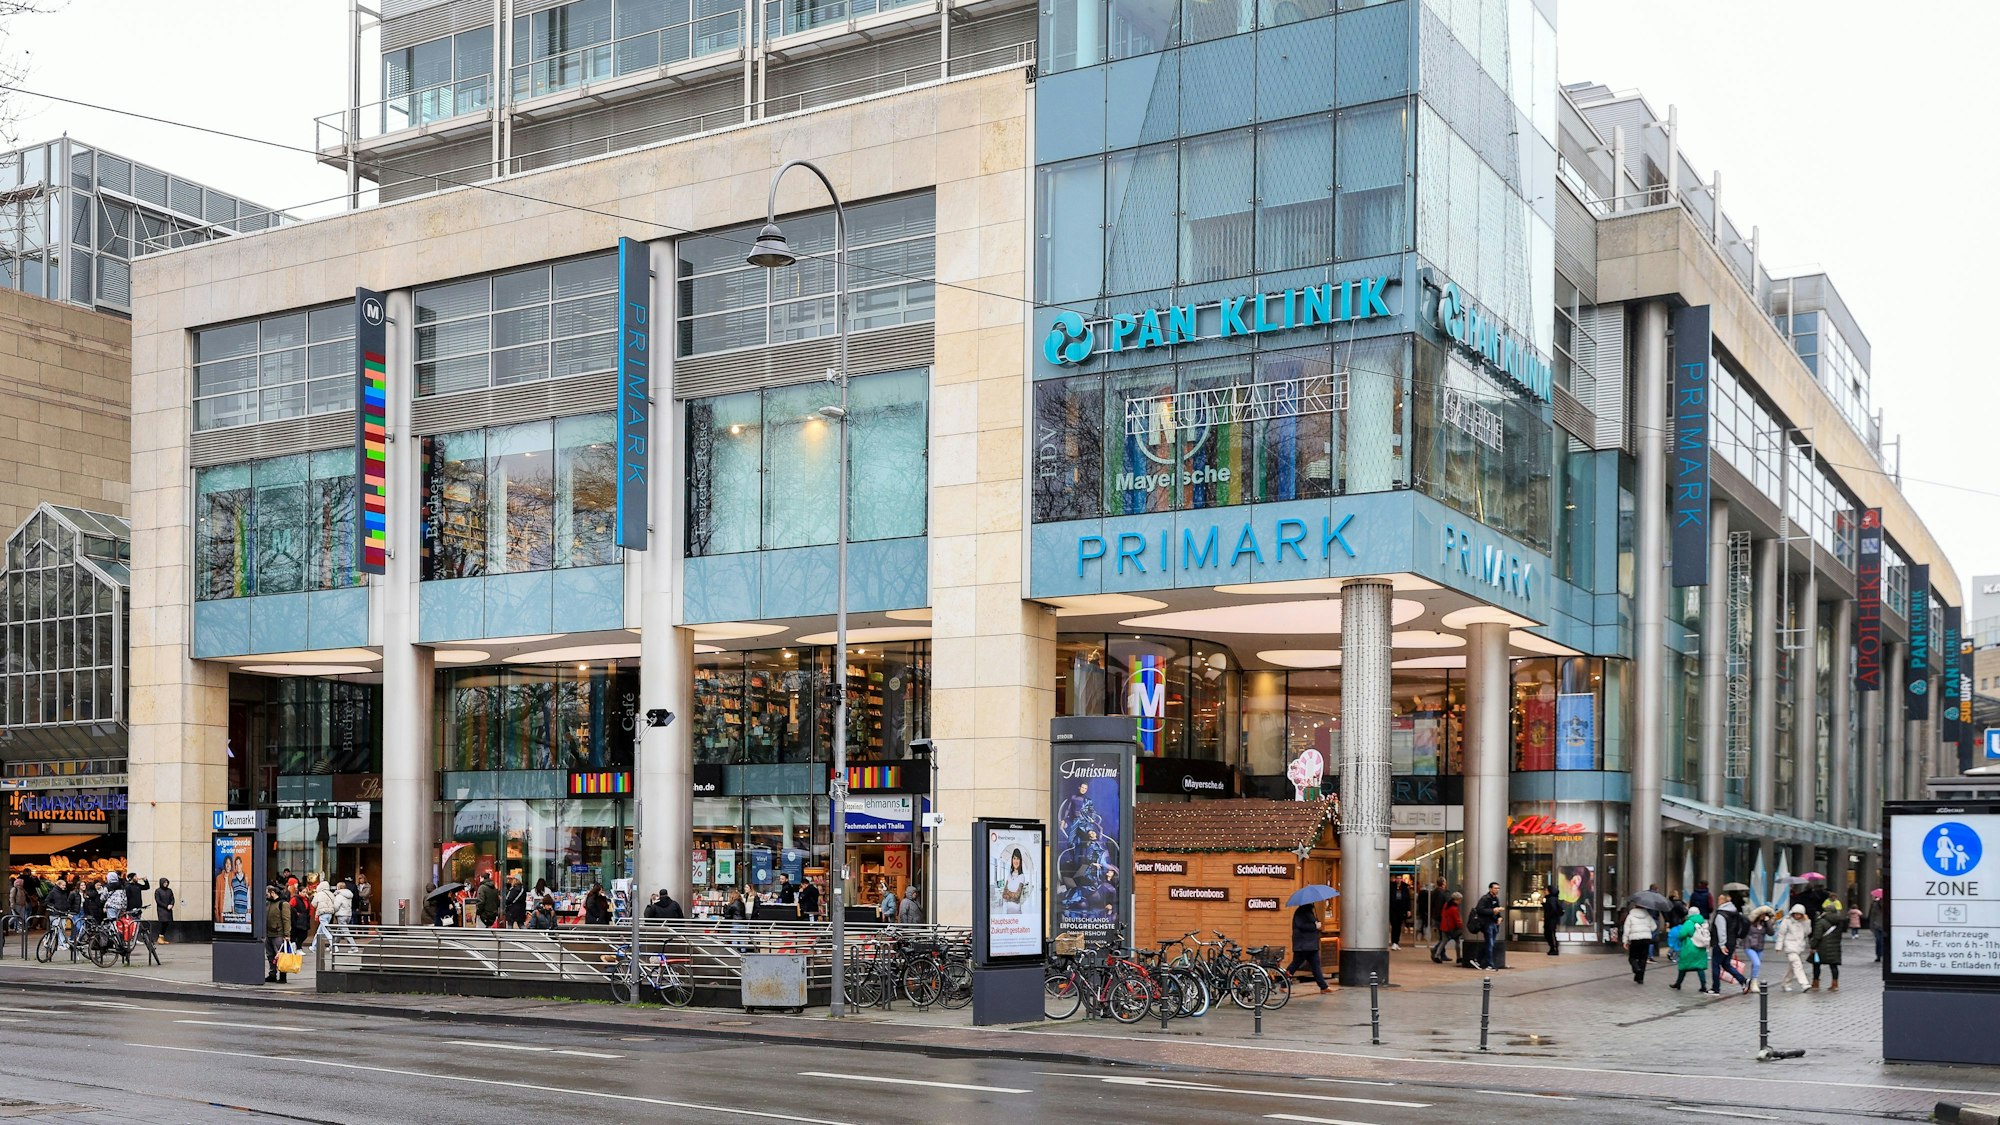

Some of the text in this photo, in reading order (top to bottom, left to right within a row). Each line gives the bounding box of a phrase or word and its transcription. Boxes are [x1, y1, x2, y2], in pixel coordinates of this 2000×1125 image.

[1113, 276, 1392, 352] PAN KLINIK
[1465, 307, 1552, 404] PAN KLINIK
[627, 301, 646, 485] PRIMARK
[1125, 372, 1349, 435] NEUMARKT
[696, 421, 707, 461] Reise
[1040, 424, 1058, 479] EDV
[1679, 362, 1704, 528] PRIMARK
[1115, 465, 1231, 492] Mayersche
[426, 476, 438, 540] Bücher
[1078, 513, 1356, 577] PRIMARK
[1441, 523, 1532, 601] PRIMARK
[1859, 561, 1880, 685] APOTHEKE
[1911, 590, 1927, 669] PAN KLINIK
[1945, 628, 1959, 697] PAN KLINIK
[1960, 674, 1973, 723] SUBWAY
[622, 692, 635, 732] Café
[343, 698, 354, 752] Bücher
[1060, 758, 1117, 779] Fantissima
[1183, 778, 1224, 790] Mayersche.de
[864, 798, 901, 809] lehmanns
[225, 815, 254, 825] Neumarkt
[844, 822, 905, 830] Fachmedien bei Thalia
[1510, 815, 1586, 834] Alice
[217, 839, 250, 848] Organspende
[1154, 862, 1183, 872] Mandeln
[1237, 865, 1287, 875] Schokofrüchte
[1171, 888, 1225, 899] Kräuterbonbons
[1925, 881, 1979, 896] ZONE
[1248, 898, 1277, 909] Glühwein
[991, 918, 1019, 926] Hauptsache
[991, 926, 1031, 935] Zukunft gestalten
[1906, 940, 1922, 948] Mo.
[1932, 940, 1943, 948] Fr.
[1917, 929, 1990, 940] Lieferfahrzeuge
[1902, 951, 1946, 960] samstags
[1951, 961, 1991, 970] Entladen
